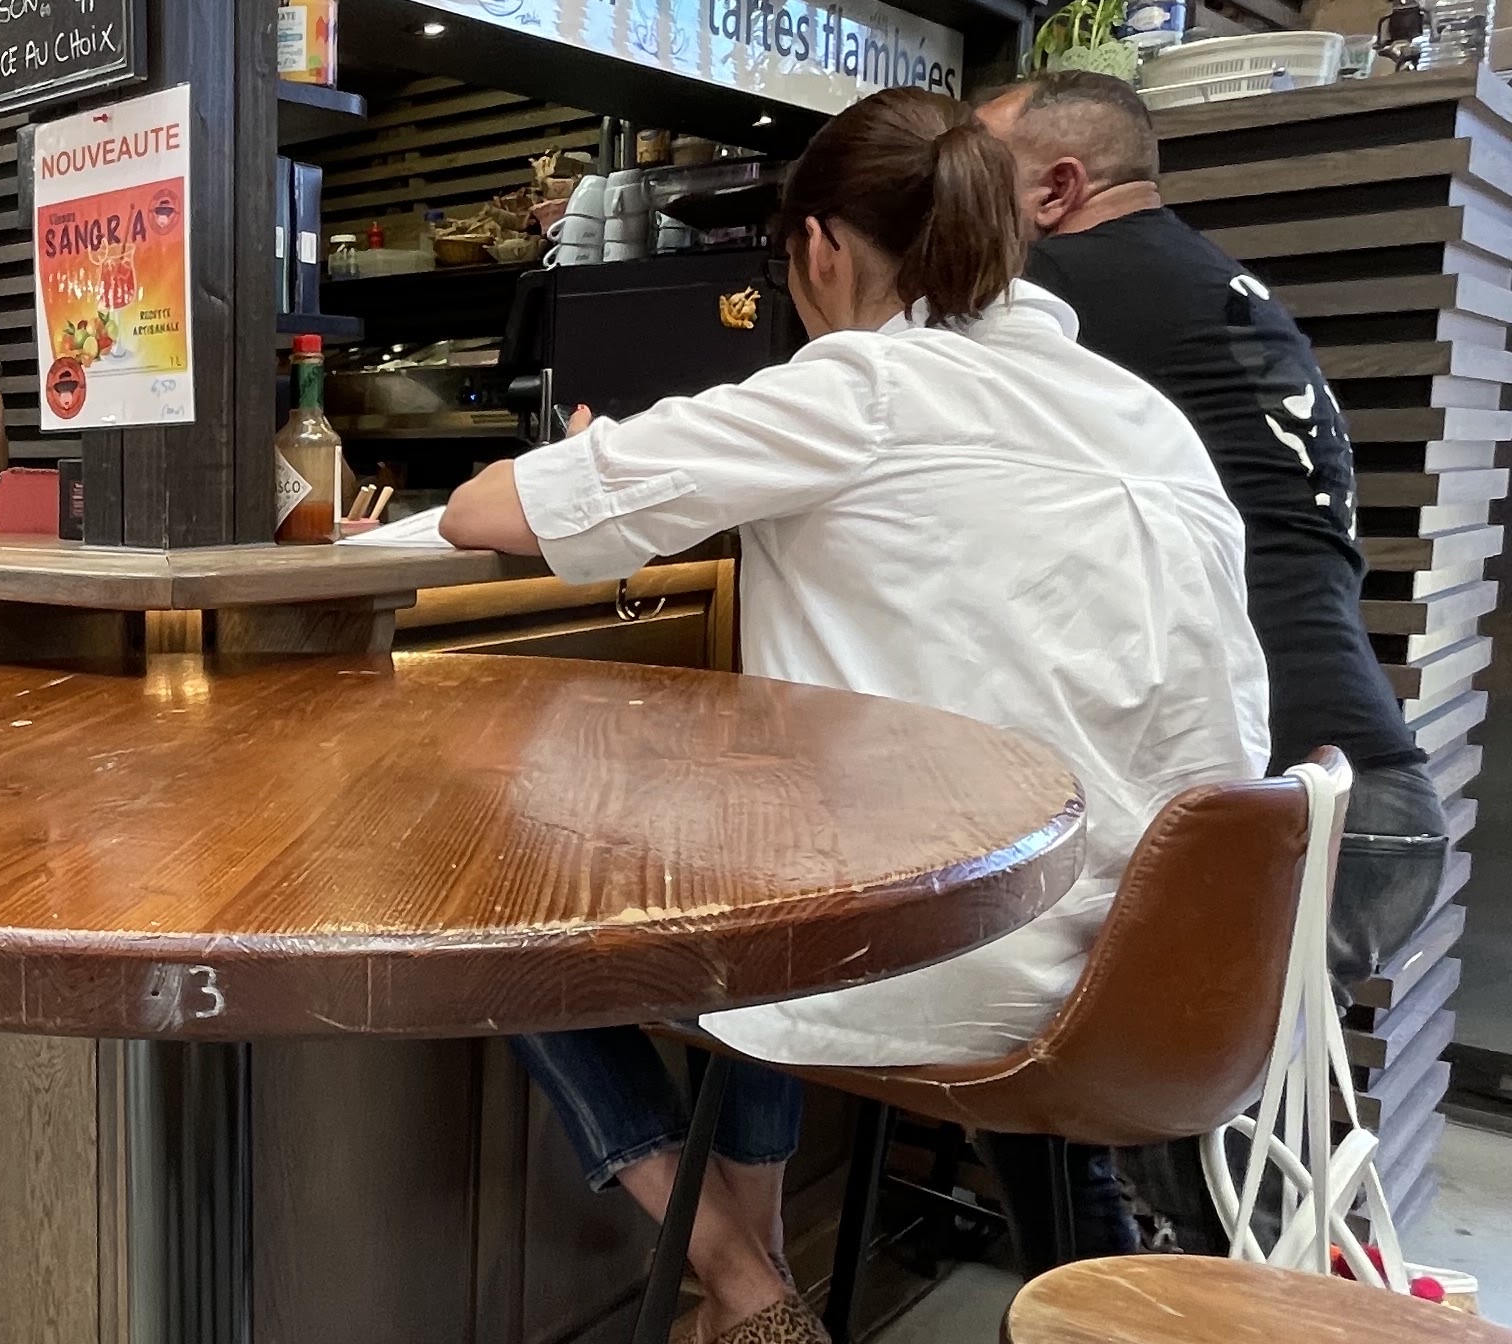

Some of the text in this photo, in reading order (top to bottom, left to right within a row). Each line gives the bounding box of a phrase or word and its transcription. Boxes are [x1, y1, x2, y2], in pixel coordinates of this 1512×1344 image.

[25, 39, 48, 69] AU
[822, 4, 958, 99] flambées
[41, 123, 180, 179] NOUVEAUTE
[276, 480, 301, 494] SCO
